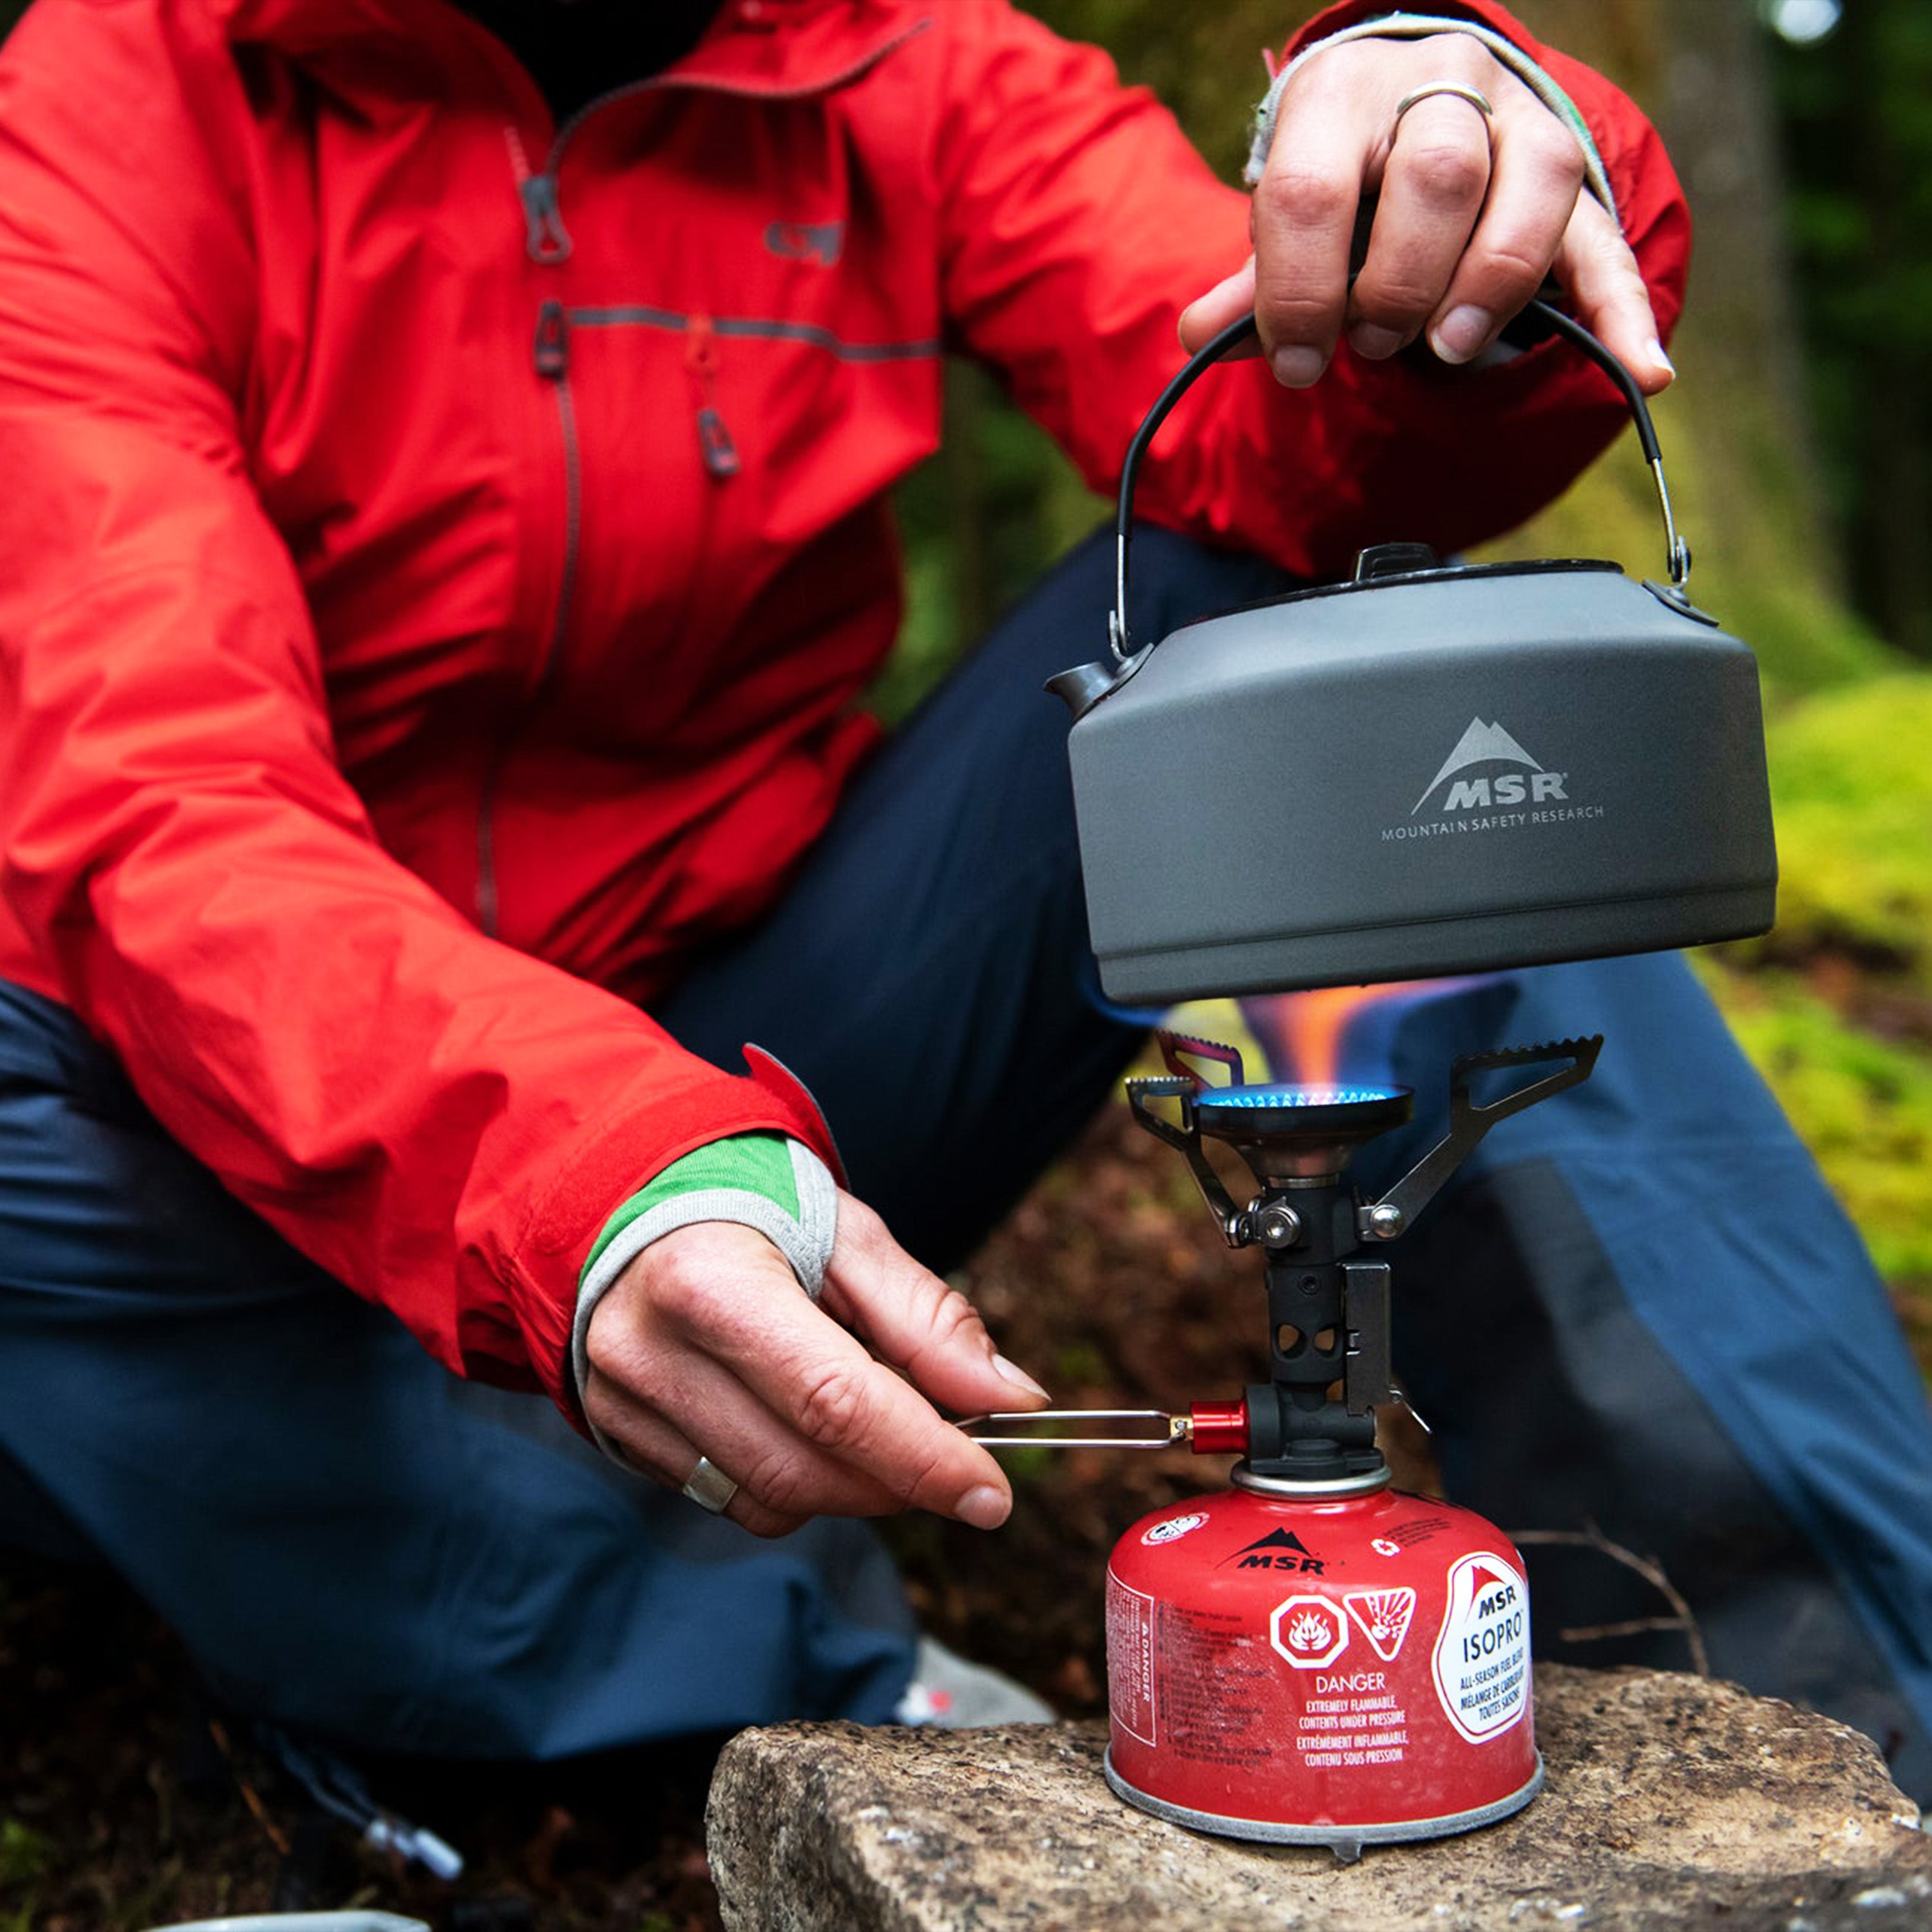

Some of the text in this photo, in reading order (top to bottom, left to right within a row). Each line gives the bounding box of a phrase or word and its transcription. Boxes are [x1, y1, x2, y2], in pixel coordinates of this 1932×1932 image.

[1443, 773, 1569, 811] MSR
[1381, 806, 1604, 840] MOUNTAIN SAFETY RESEARCH
[1237, 1555, 1325, 1576] MSR
[1479, 1585, 1517, 1619] MSR
[1142, 1638, 1151, 1702] DANGER
[1316, 1672, 1386, 1694] DANGER
[1306, 1700, 1349, 1714] EXTREMELY
[1299, 1710, 1405, 1730] CONTENTS UNDER PRESSURE
[1305, 1747, 1403, 1767] CONTENU SOUS PRESSION
